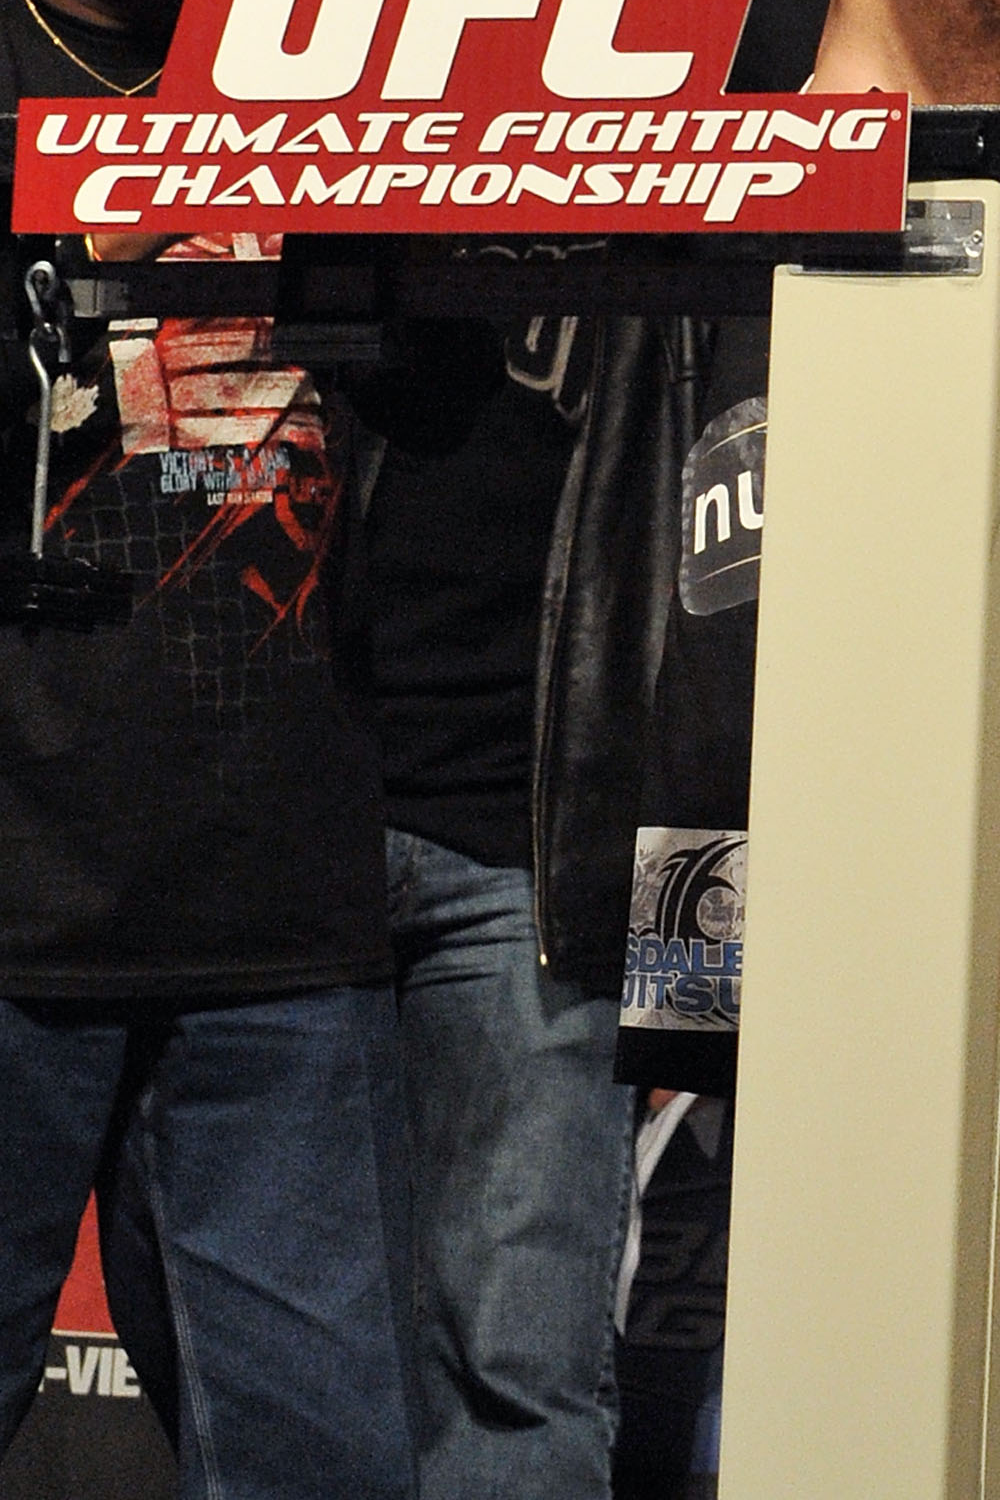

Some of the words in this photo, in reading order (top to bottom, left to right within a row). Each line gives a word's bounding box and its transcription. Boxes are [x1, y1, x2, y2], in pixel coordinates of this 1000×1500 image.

[36, 112, 464, 155] ULTIMATE
[477, 108, 892, 153] FIGHTING
[73, 160, 806, 223] CHAMPIONSHIP
